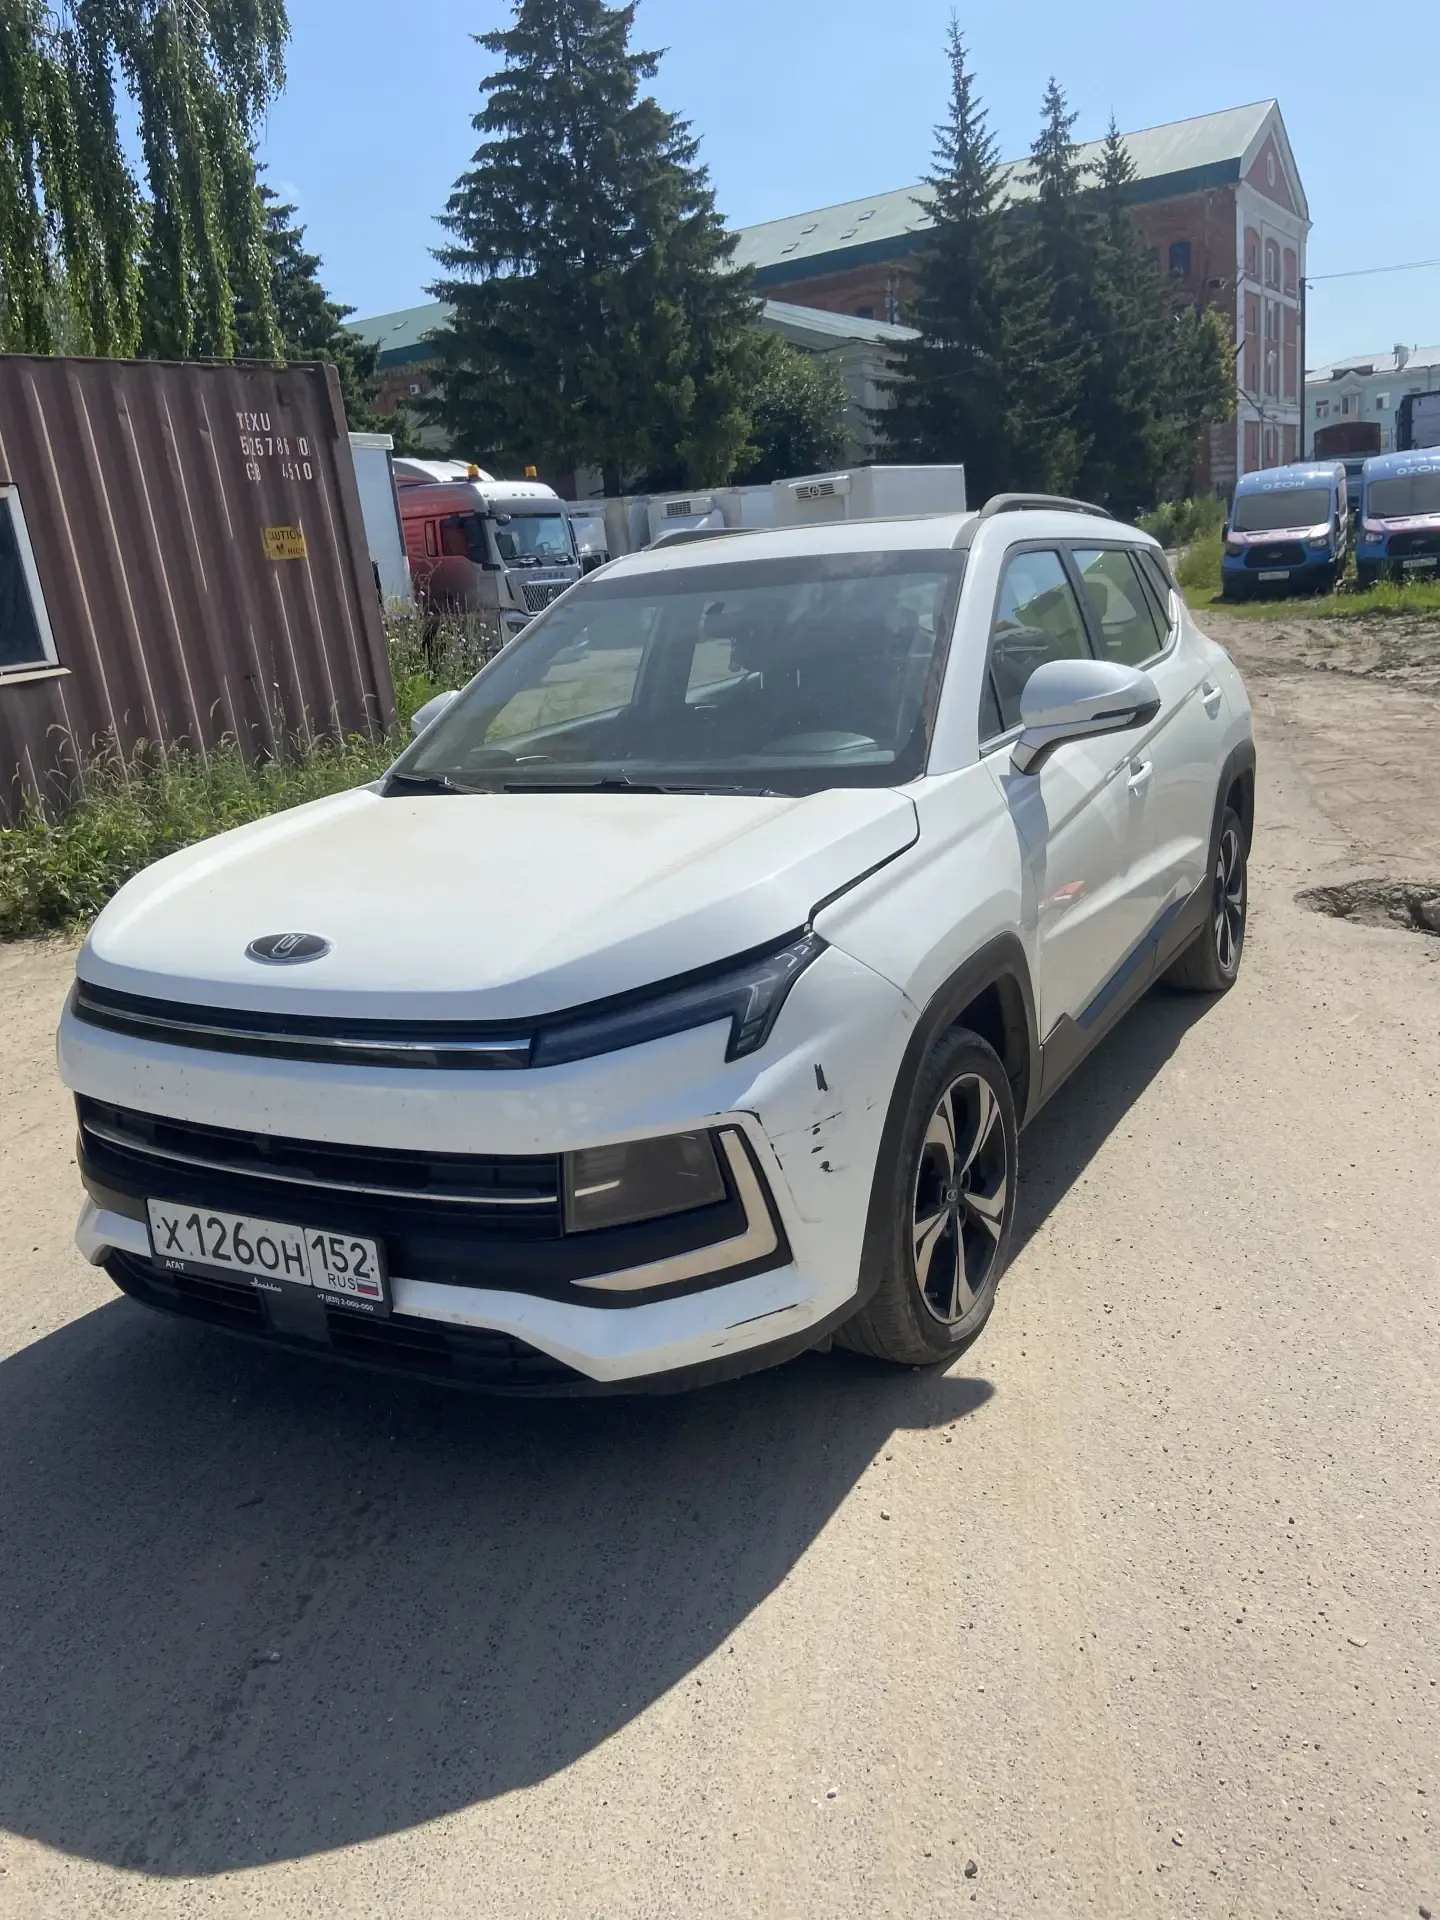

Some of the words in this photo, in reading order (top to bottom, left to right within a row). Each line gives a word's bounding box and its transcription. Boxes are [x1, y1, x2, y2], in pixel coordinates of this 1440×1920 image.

[236, 412, 271, 431] TEXU
[240, 436, 290, 456] 525786
[298, 437, 310, 456] 0
[282, 462, 312, 481] 4510
[1262, 481, 1305, 490] OZON
[161, 1213, 305, 1277] Х126ОН
[311, 1235, 371, 1279] 152
[165, 1259, 185, 1271] АГАТ
[328, 1273, 356, 1290] RUS
[340, 1298, 374, 1312] 2-000-000
